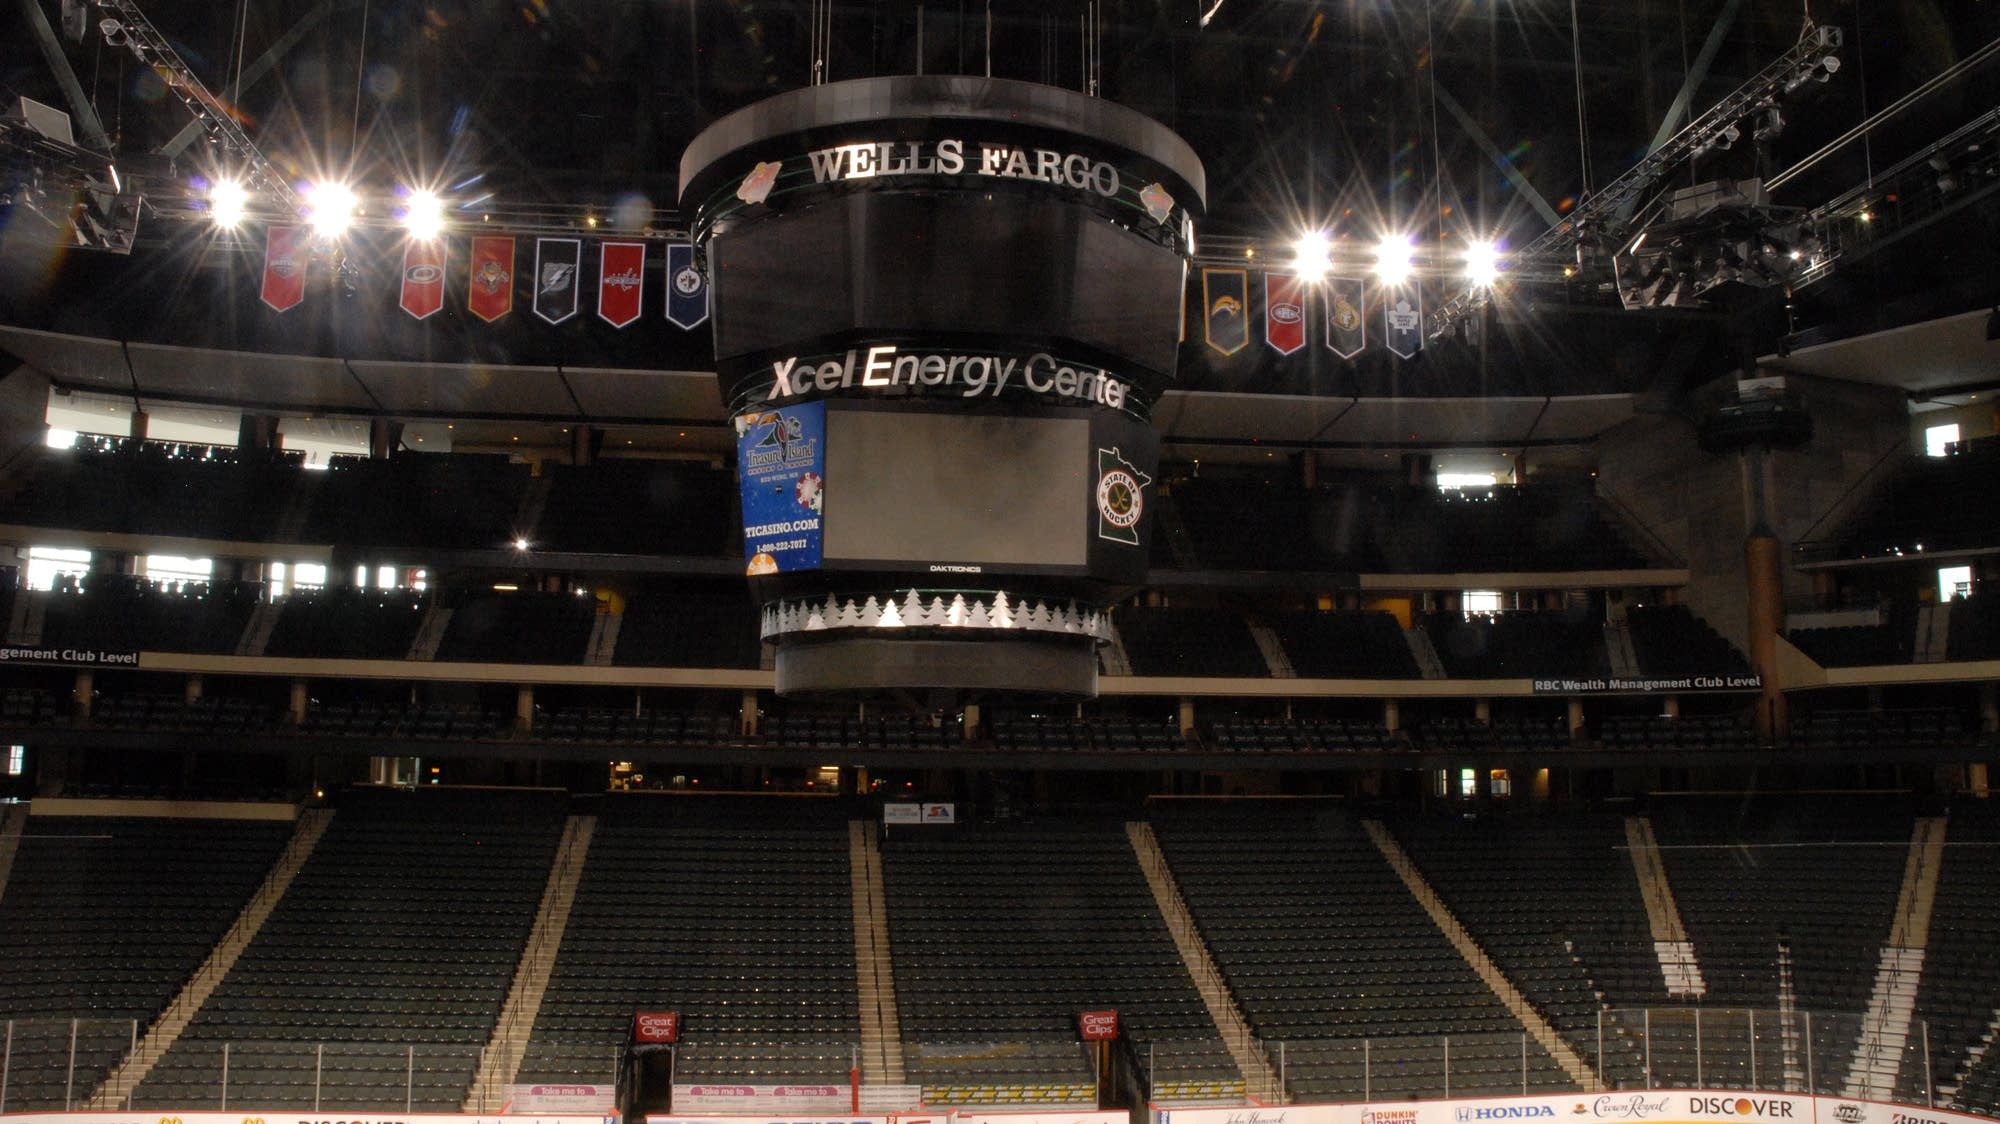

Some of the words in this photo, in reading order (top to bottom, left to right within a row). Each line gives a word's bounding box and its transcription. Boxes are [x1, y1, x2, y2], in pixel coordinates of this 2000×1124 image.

[808, 139, 964, 183] WELLS
[978, 144, 1120, 197] FARGO
[767, 350, 857, 399] Xcel
[862, 346, 1016, 396] Energy
[1024, 352, 1131, 408] Center
[788, 439, 815, 460] Island
[1104, 473, 1128, 488] STATE
[1128, 481, 1136, 494] OF
[1104, 505, 1134, 525] HOCKEY
[745, 518, 819, 538] TICASINO.COM
[0, 648, 58, 660] gement
[62, 649, 96, 661] Club
[100, 651, 137, 664] Level
[1535, 680, 1560, 691] RBC
[1562, 679, 1606, 691] Wealth
[1609, 677, 1691, 691] Management
[1694, 677, 1723, 688] Club
[1727, 676, 1761, 687] Level
[639, 1015, 672, 1026] Great
[1083, 1015, 1114, 1025] Great
[642, 1025, 670, 1038] Clips
[1086, 1024, 1113, 1036] Clips
[541, 1087, 560, 1096] Take
[562, 1088, 575, 1096] me
[577, 1087, 586, 1096] to
[701, 1087, 720, 1096] Take
[721, 1088, 733, 1096] me
[735, 1087, 745, 1096] to
[803, 1088, 816, 1096] me
[818, 1087, 828, 1096] to
[1475, 1105, 1555, 1120] HONDA
[1593, 1095, 1627, 1118] Crown
[1622, 1095, 1669, 1118] Royal
[1690, 1097, 1794, 1118] DISCOVER
